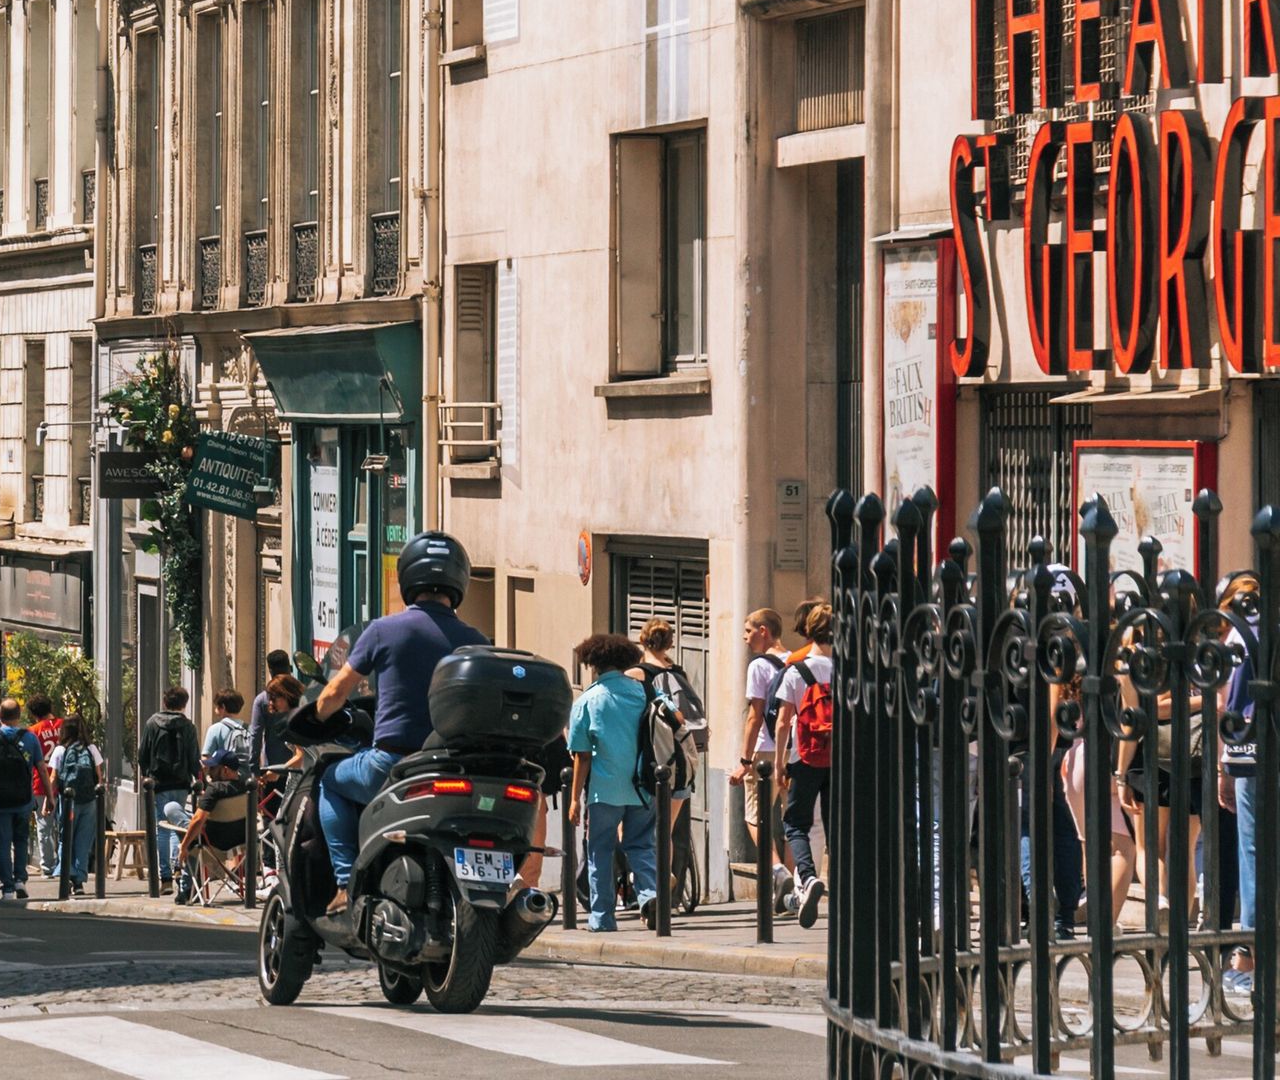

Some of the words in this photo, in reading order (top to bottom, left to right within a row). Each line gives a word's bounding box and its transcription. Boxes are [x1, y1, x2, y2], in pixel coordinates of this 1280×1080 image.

[895, 360, 924, 396] FAUX
[889, 391, 933, 428] BRITISH
[198, 457, 261, 487] ANTIQUITÉS
[785, 485, 800, 497] 51
[317, 600, 327, 628] 45
